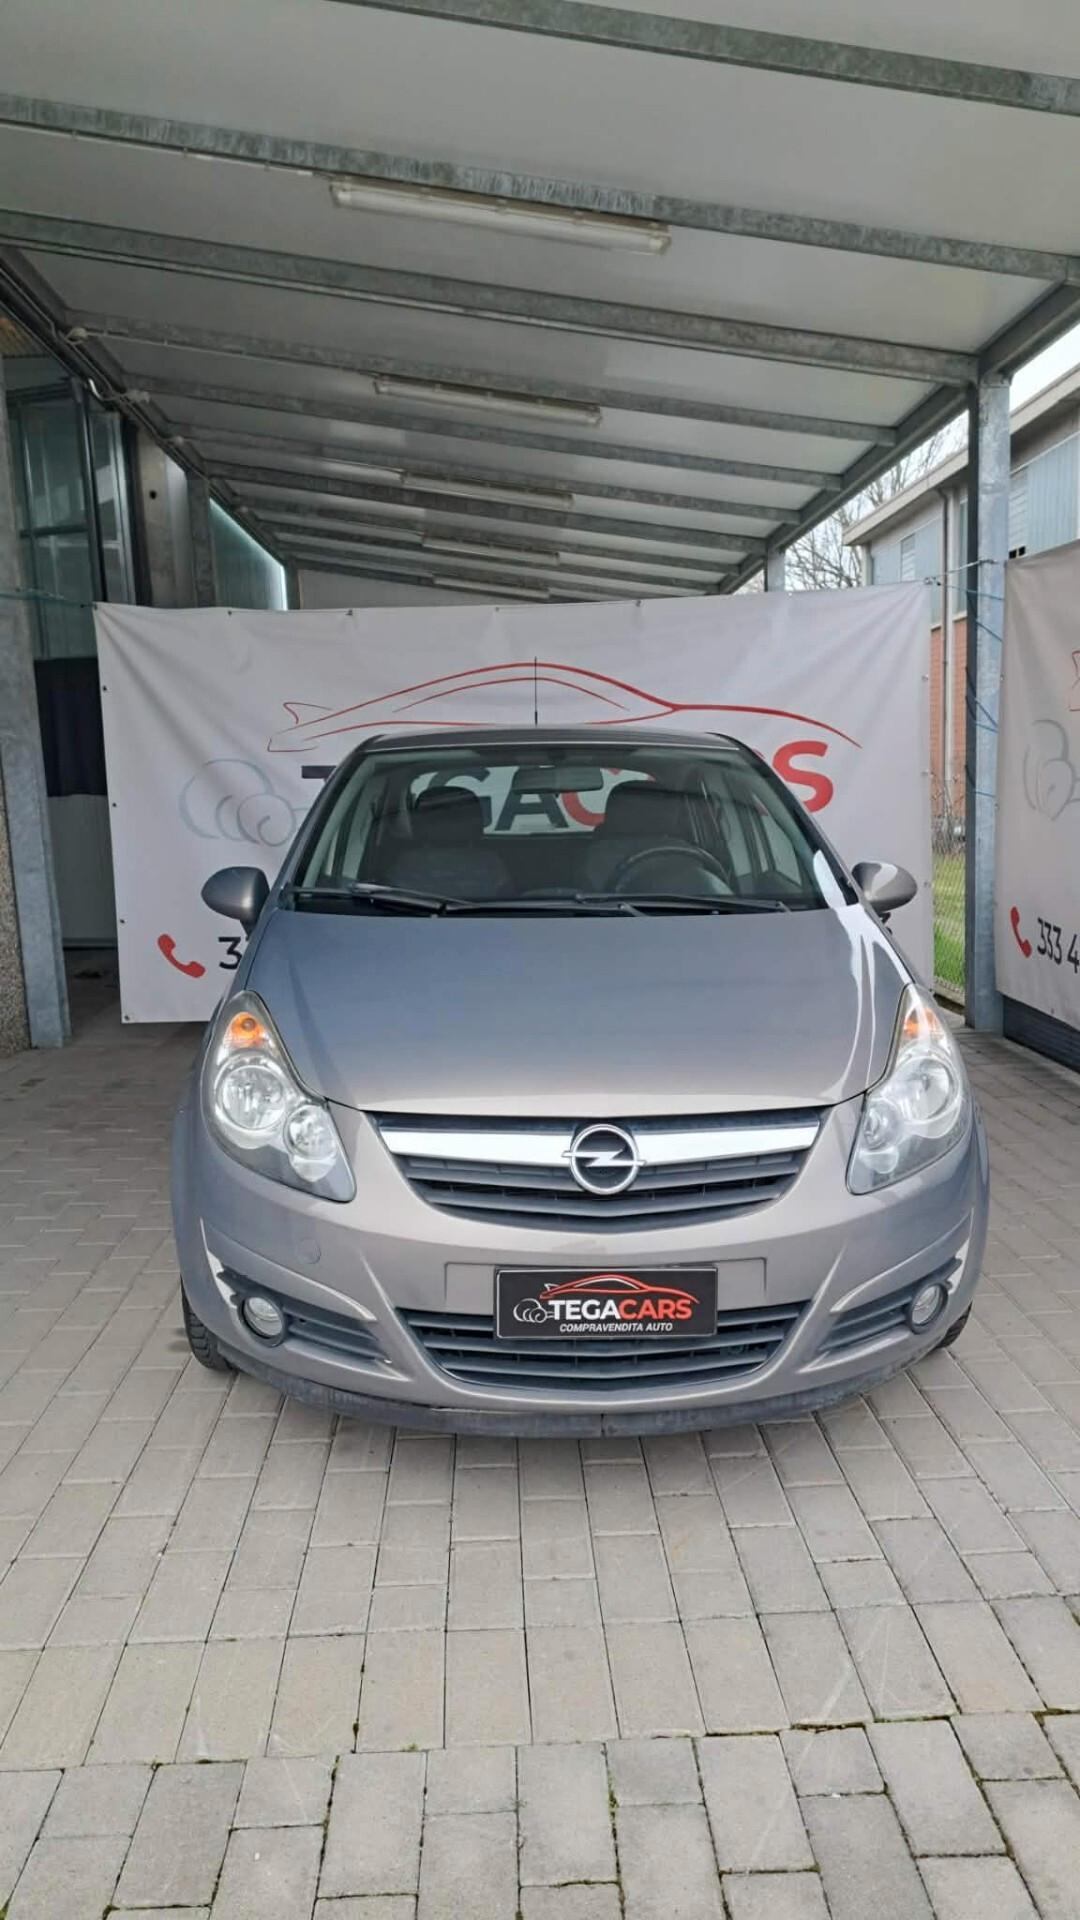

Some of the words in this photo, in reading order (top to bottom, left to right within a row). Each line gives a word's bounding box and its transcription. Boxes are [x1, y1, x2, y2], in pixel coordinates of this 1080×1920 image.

[1037, 917, 1062, 965] 333
[549, 1299, 692, 1320] TEGACARS
[559, 1322, 644, 1333] COMPRAVENDITA
[646, 1322, 673, 1332] AUTO
